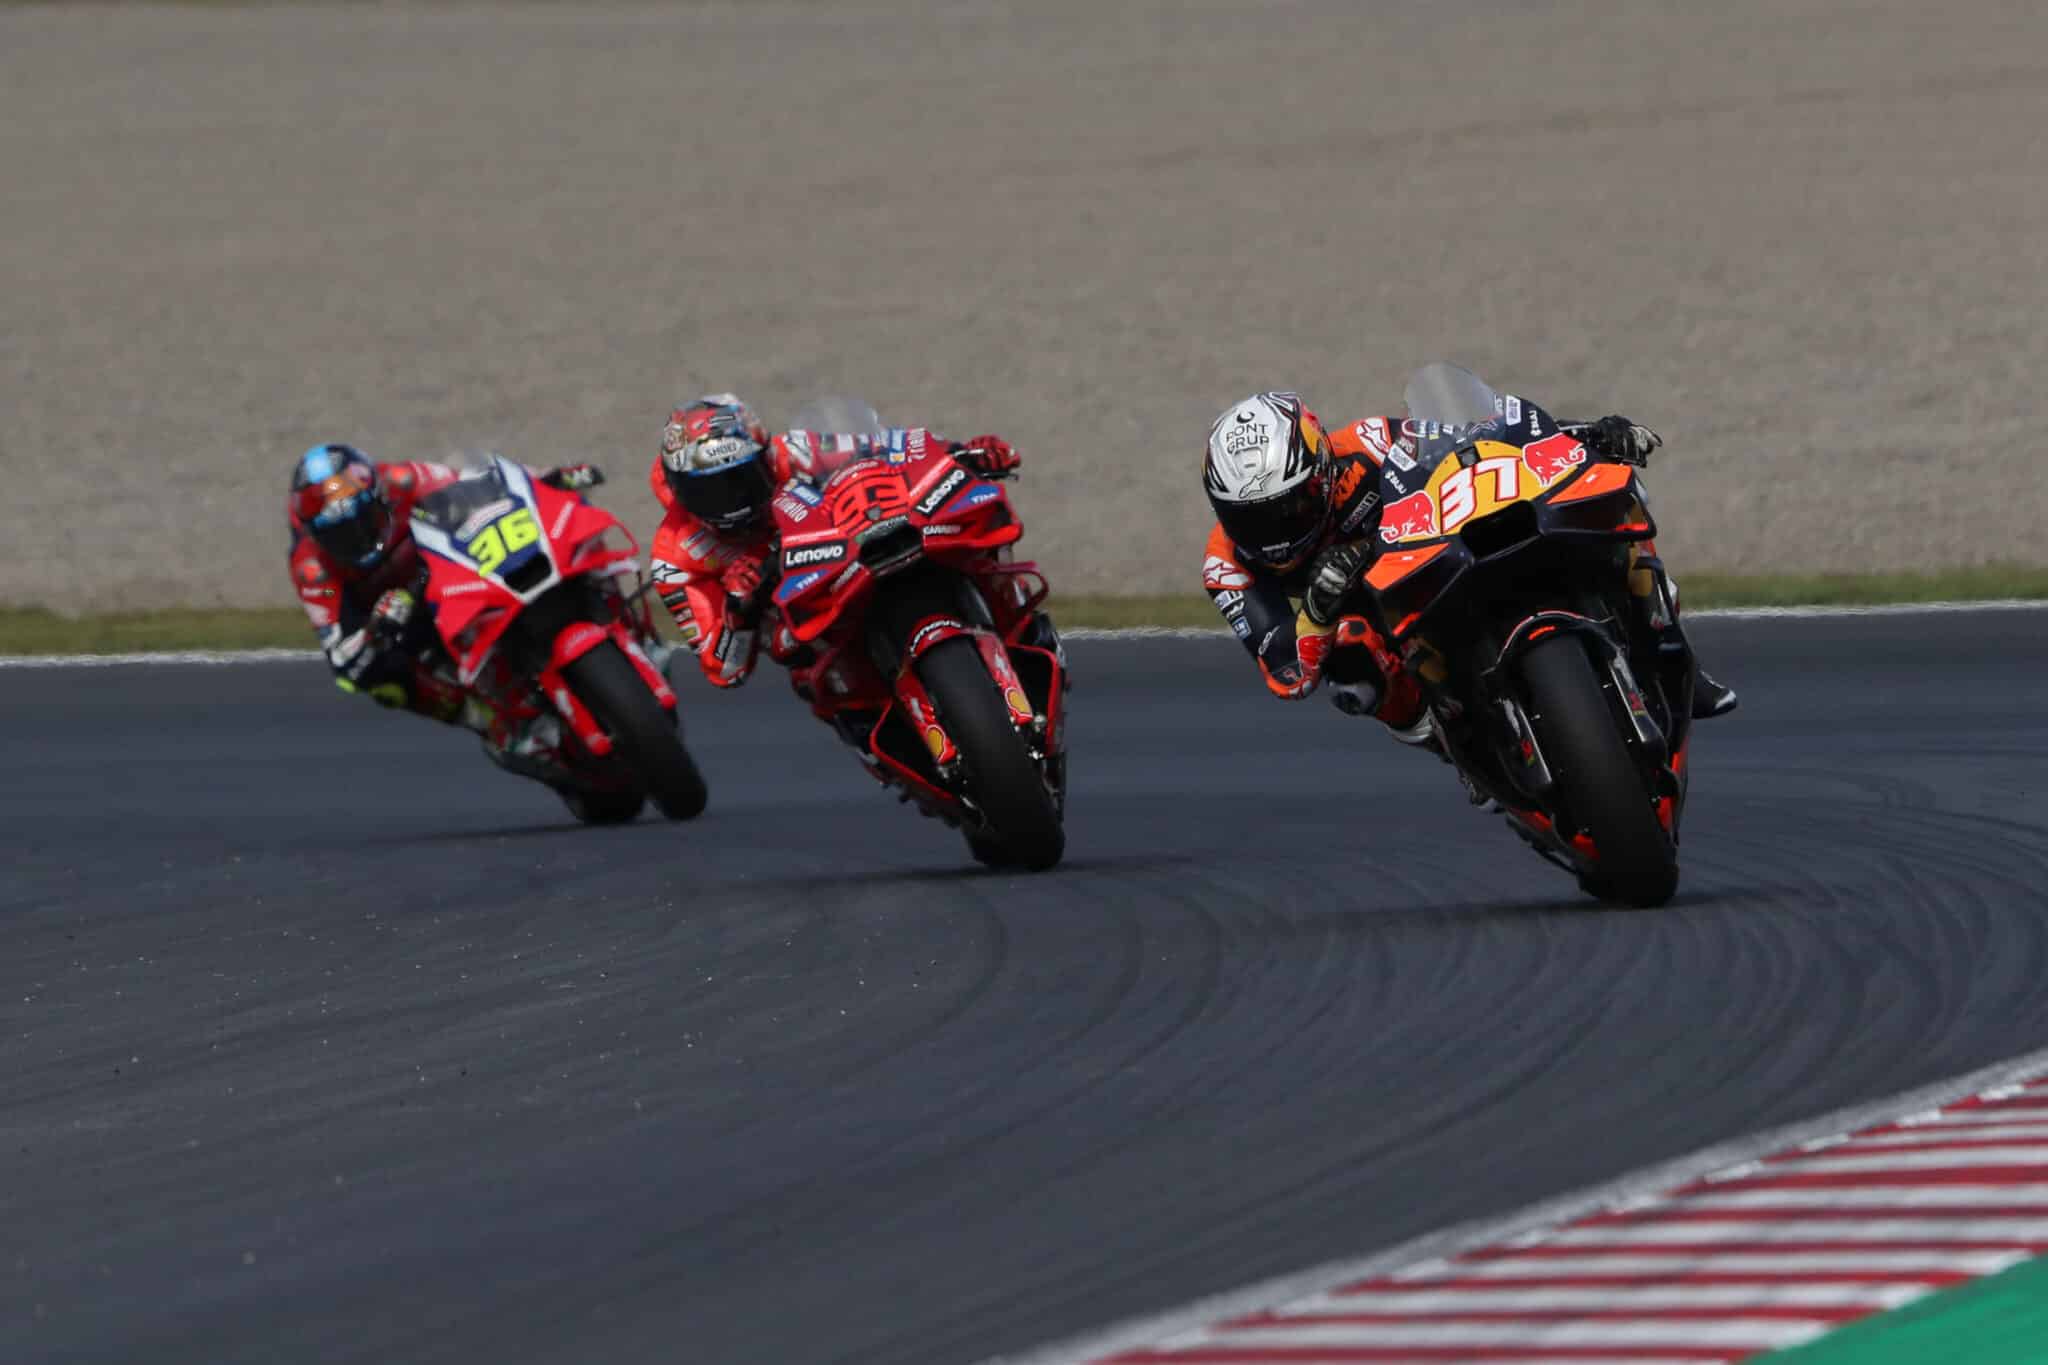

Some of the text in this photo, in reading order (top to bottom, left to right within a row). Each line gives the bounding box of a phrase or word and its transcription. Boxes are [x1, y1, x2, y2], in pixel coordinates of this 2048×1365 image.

[705, 441, 737, 457] SHOEI
[1226, 423, 1267, 443] PONT
[1226, 435, 1270, 455] GRUP
[831, 475, 909, 537] 93
[916, 469, 966, 514] Lenovo
[1439, 455, 1521, 536] 37
[467, 507, 540, 578] 36
[785, 545, 844, 566] Lenovo
